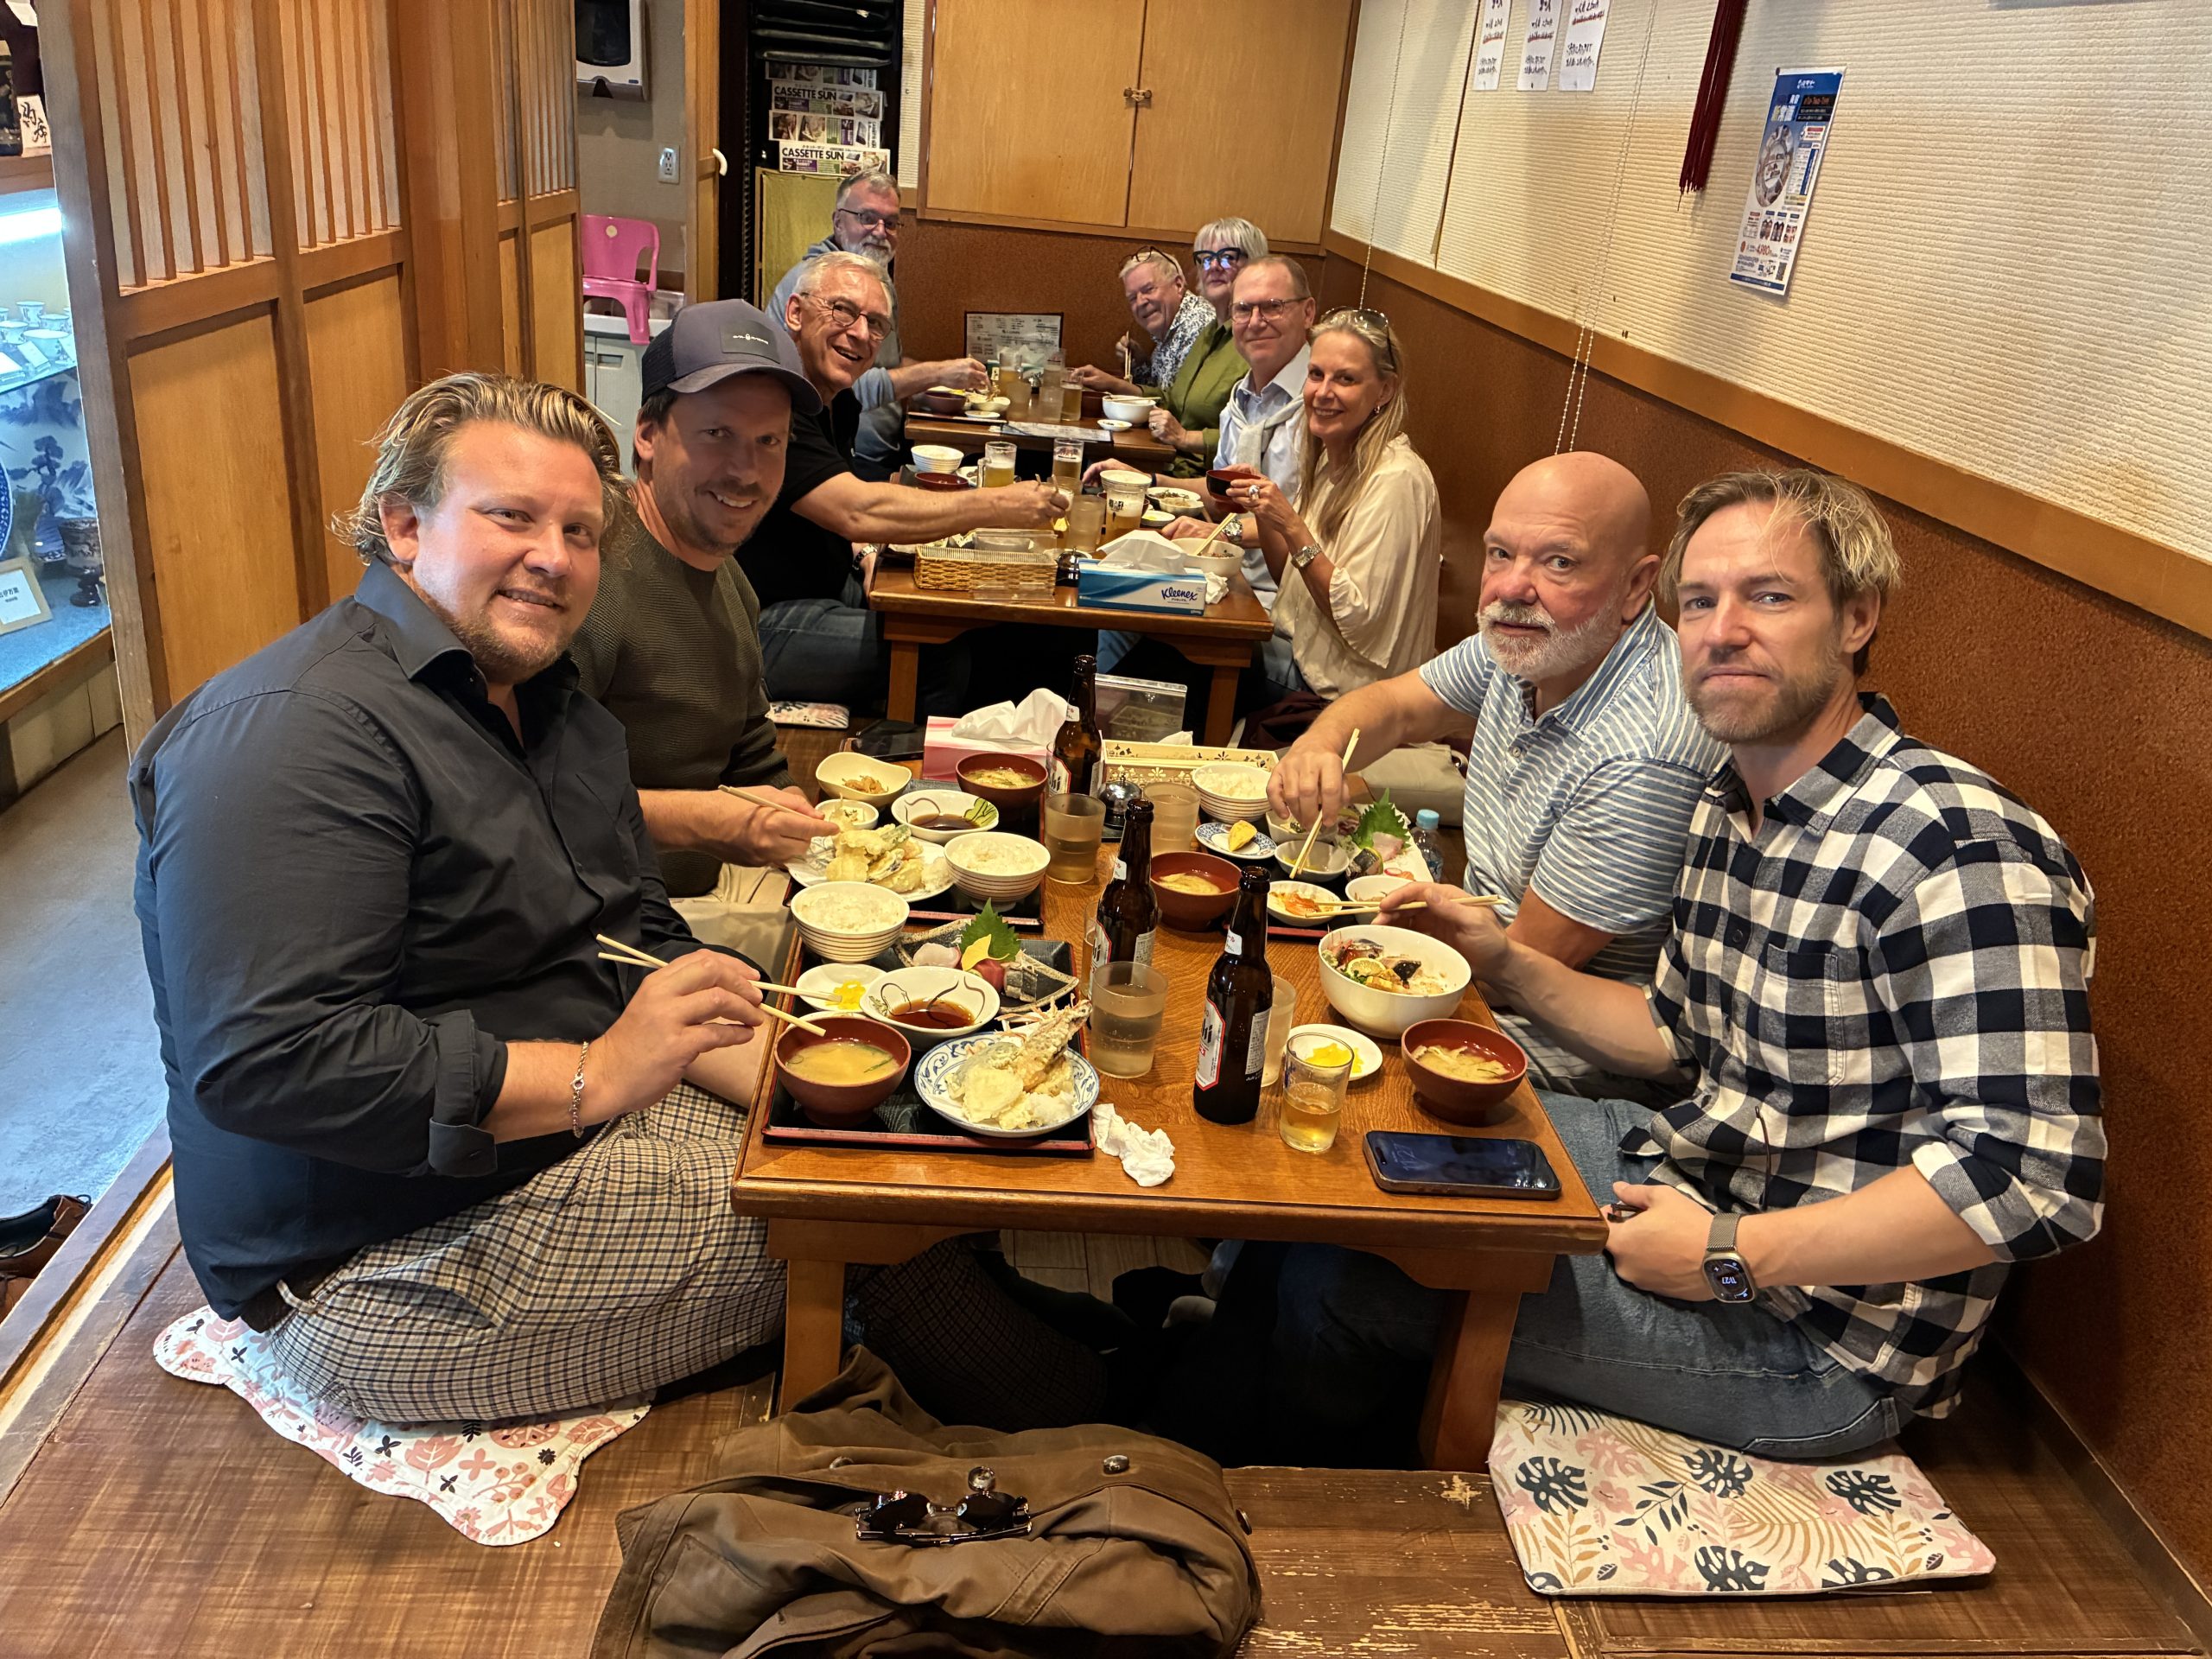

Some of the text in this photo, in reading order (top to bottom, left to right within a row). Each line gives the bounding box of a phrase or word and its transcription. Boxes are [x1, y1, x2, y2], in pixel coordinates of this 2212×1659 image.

[774, 86, 817, 99] CASSETTE
[817, 90, 837, 100] SUN
[782, 147, 823, 159] CASSETTE
[825, 150, 844, 161] SUN
[1160, 586, 1198, 601] Kleenex
